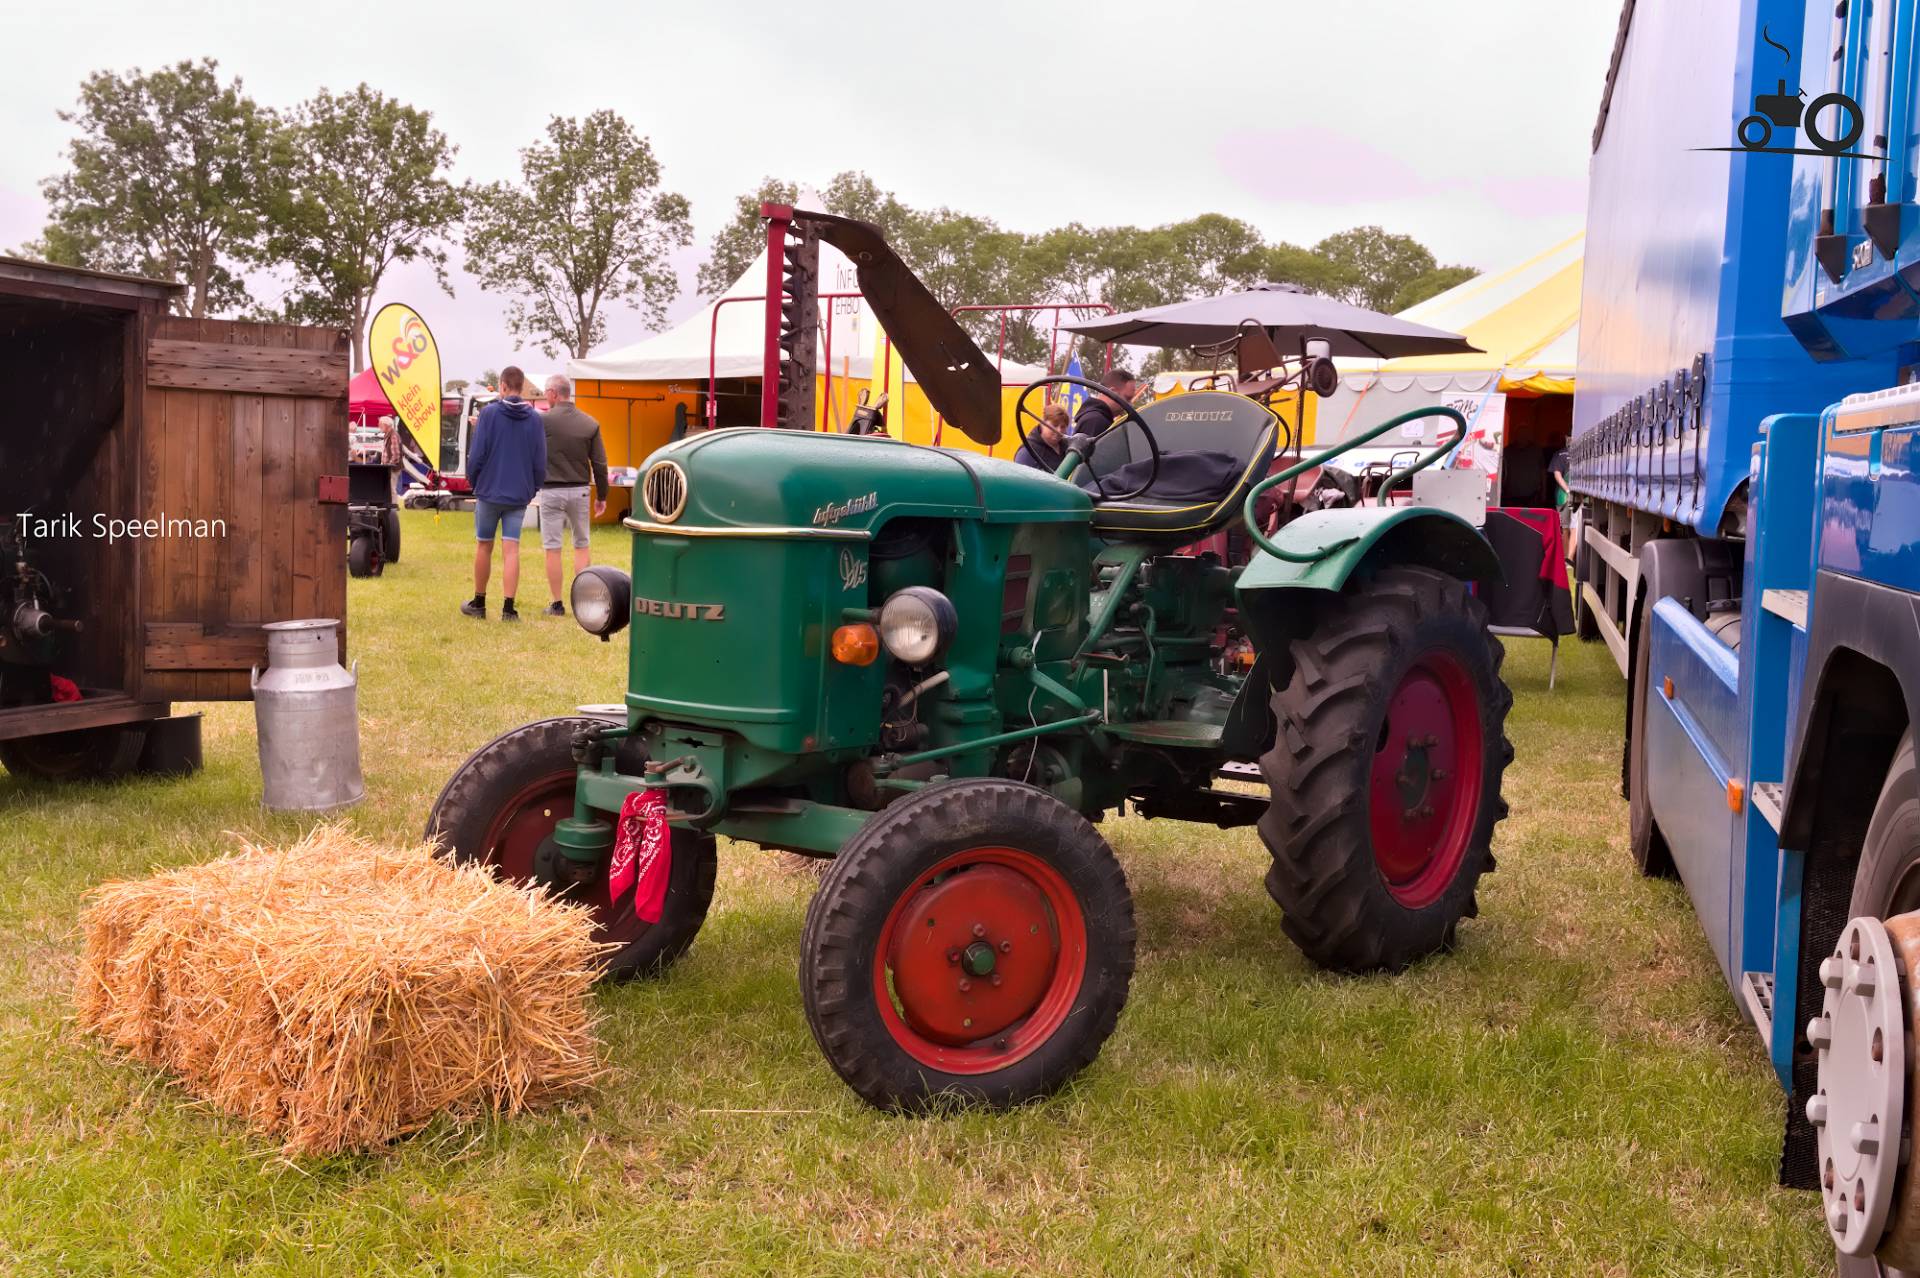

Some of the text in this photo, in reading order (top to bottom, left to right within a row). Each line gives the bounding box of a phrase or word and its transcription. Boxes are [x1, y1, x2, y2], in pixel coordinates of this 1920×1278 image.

[397, 383, 421, 411] klein
[406, 398, 424, 421] dier
[413, 402, 437, 431] show
[1165, 409, 1233, 422] DEUTZ
[635, 597, 724, 620] DEUTZ
